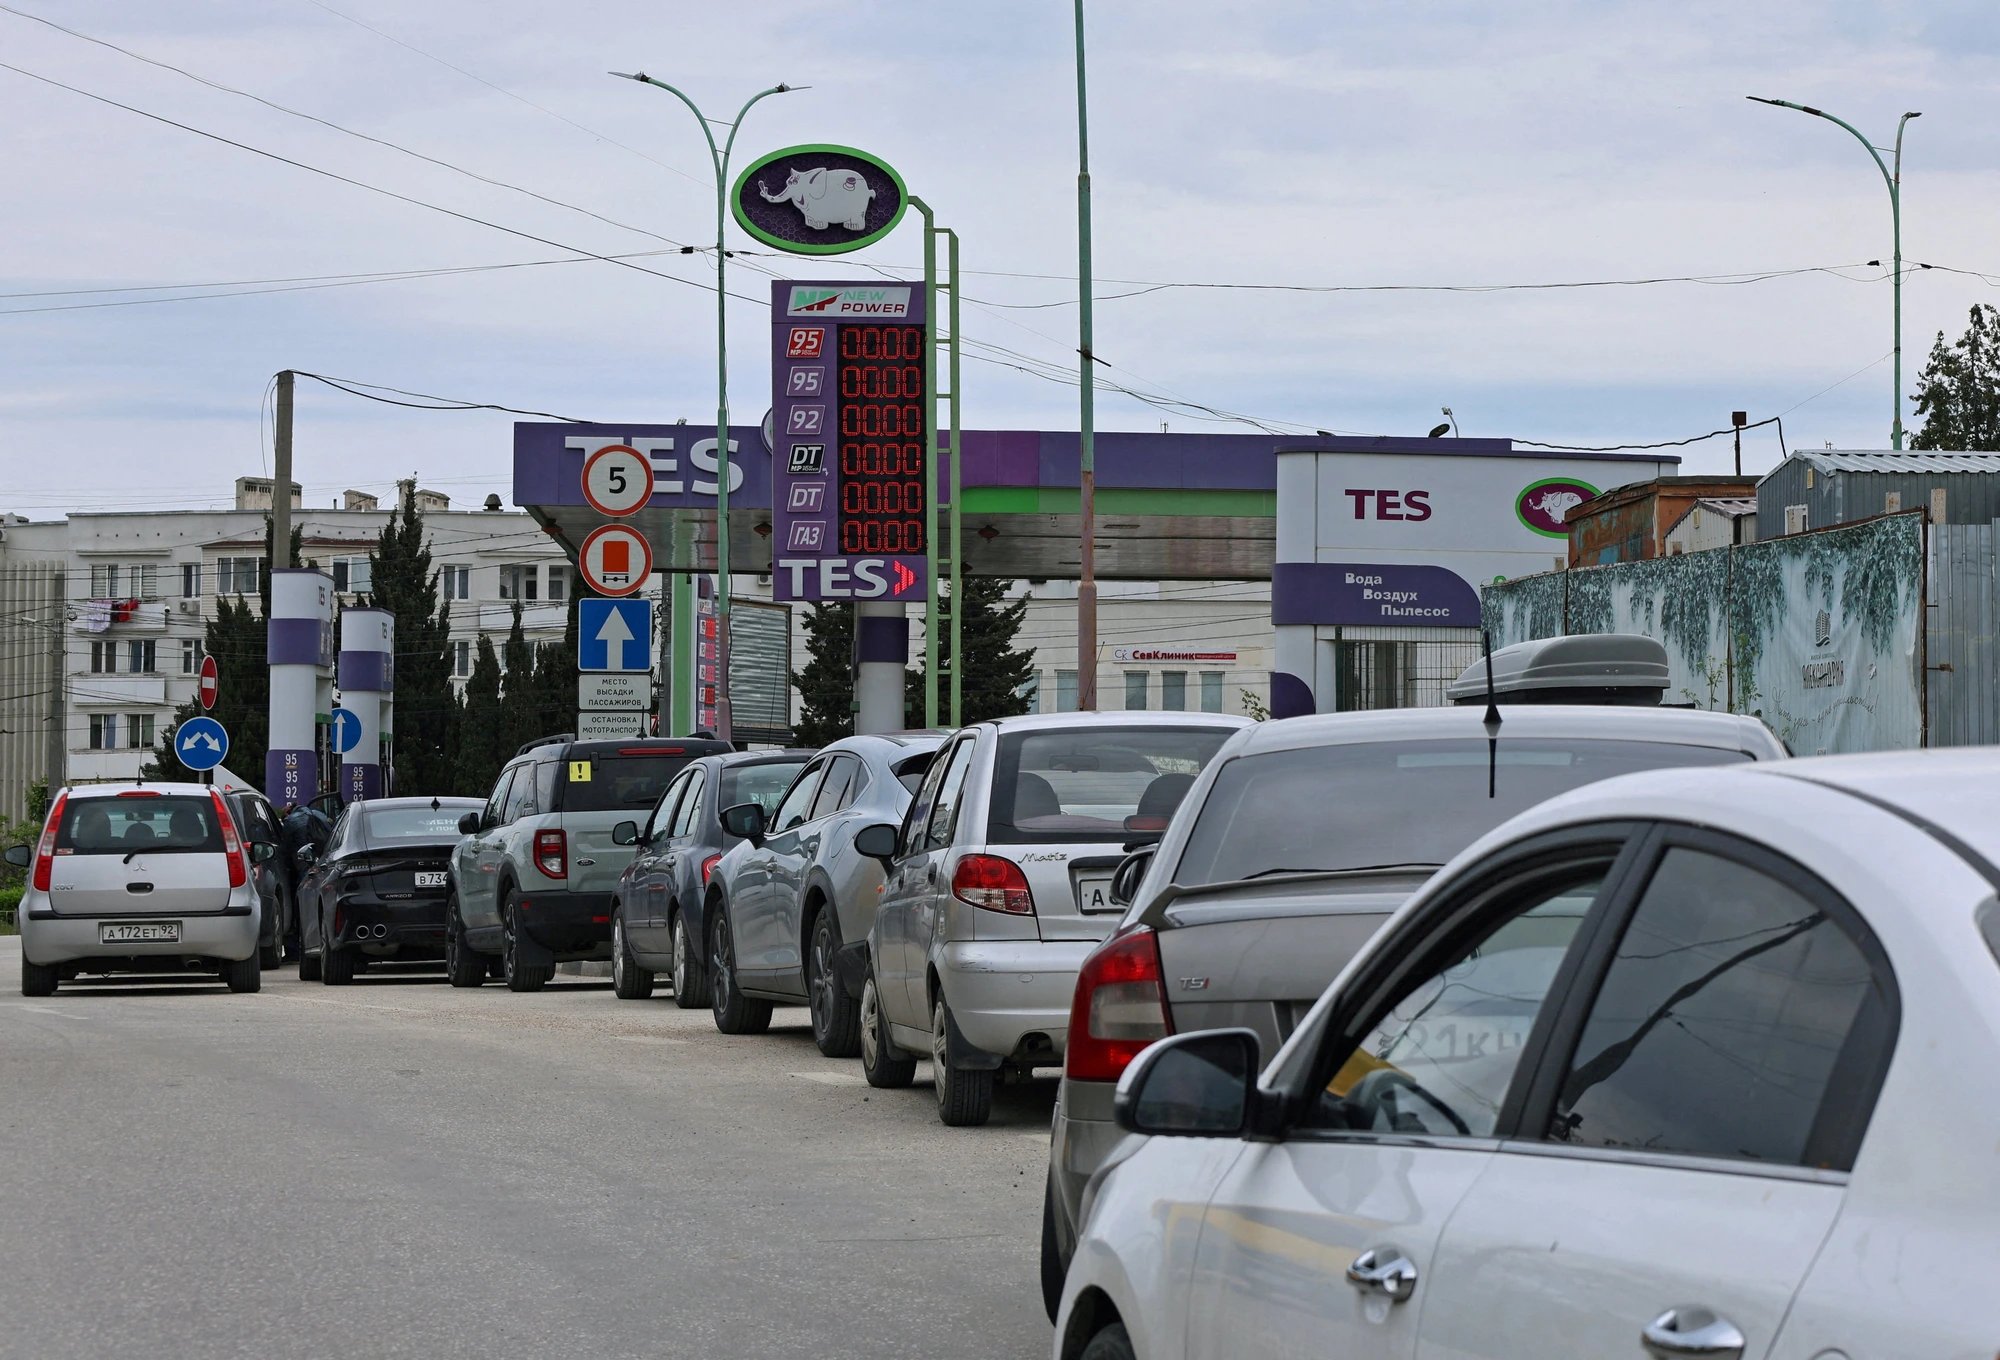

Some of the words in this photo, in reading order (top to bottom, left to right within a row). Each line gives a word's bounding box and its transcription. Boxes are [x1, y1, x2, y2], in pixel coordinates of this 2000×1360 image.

[844, 290, 887, 301] NEW
[841, 303, 905, 314] POWER
[793, 331, 819, 349] 95
[793, 372, 819, 391] 95
[793, 410, 820, 429] 92
[792, 446, 821, 465] DT
[565, 436, 744, 495] TES
[608, 467, 627, 494] 5
[792, 488, 821, 506] DT
[1345, 489, 1432, 521] TES
[794, 526, 820, 545] ГАЗ
[779, 559, 888, 597] TES
[1345, 573, 1382, 586] Вода
[1363, 589, 1418, 603] Воздух
[1381, 604, 1450, 616] Пылесос
[1132, 650, 1195, 660] СевКлиник
[285, 753, 297, 765] 95
[286, 771, 298, 783] 95
[353, 766, 364, 777] 95
[285, 786, 298, 798] 92
[353, 781, 364, 791] 95
[1017, 852, 1067, 864] Matiz
